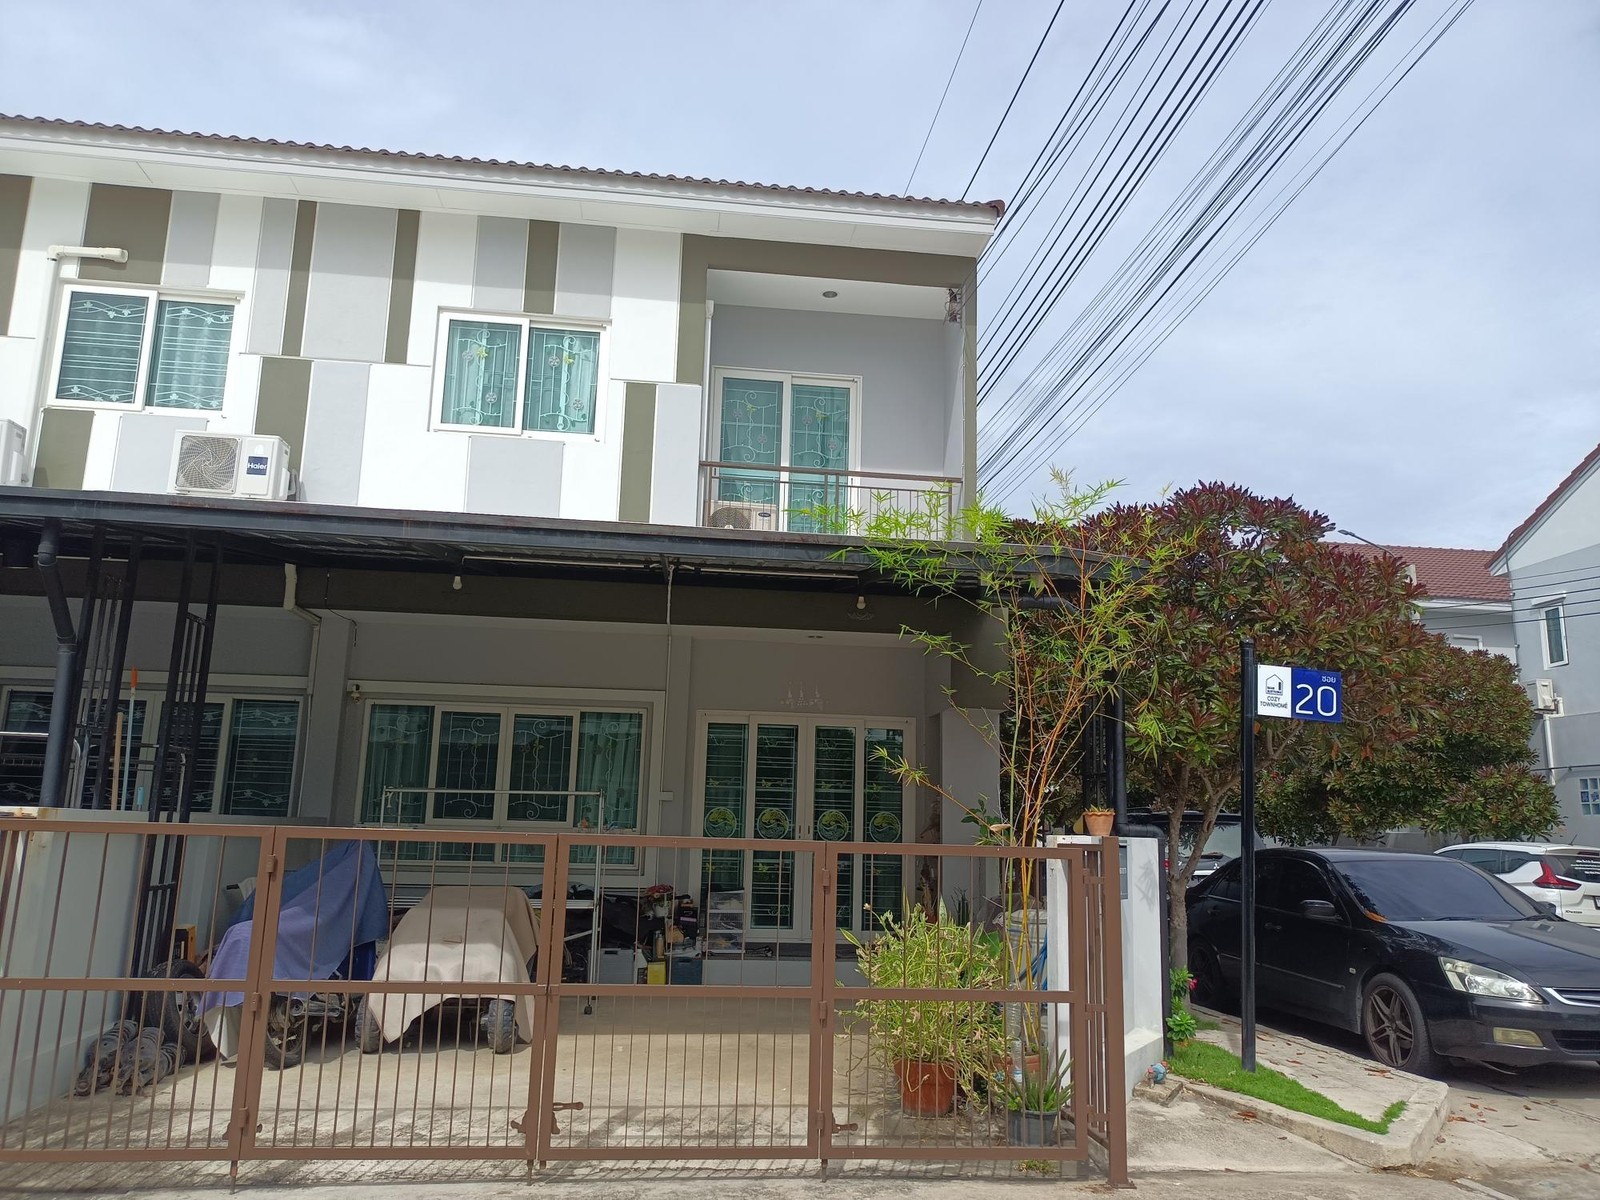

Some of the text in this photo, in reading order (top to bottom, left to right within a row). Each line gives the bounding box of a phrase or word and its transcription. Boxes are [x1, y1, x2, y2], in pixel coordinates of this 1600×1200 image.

[247, 462, 267, 470] Haier
[1321, 675, 1336, 683] ซอย
[1296, 683, 1337, 717] 20
[1260, 700, 1288, 709] TOWNHOME
